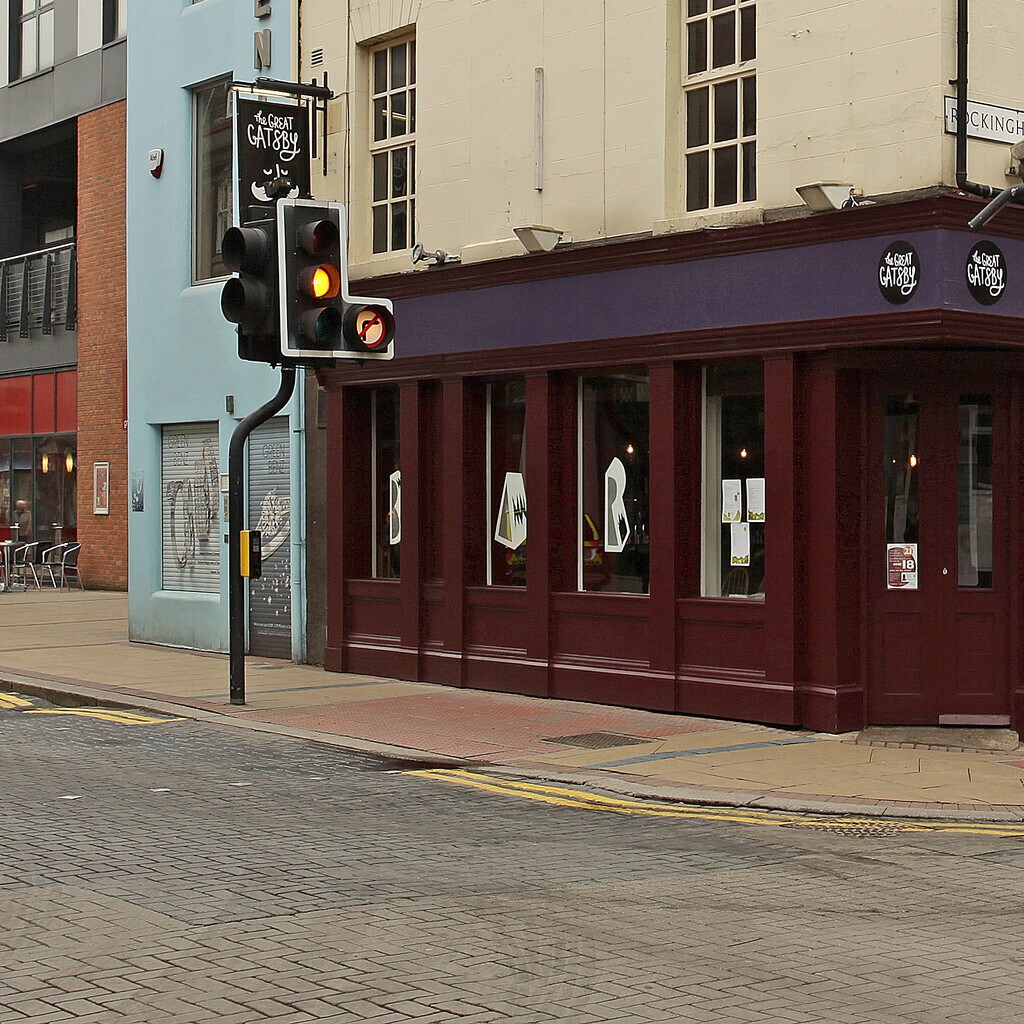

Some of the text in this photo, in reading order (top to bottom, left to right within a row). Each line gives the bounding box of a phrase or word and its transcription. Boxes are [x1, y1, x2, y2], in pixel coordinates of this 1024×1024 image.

[254, 110, 294, 130] the GREAT
[247, 124, 301, 161] GATSBY
[894, 252, 913, 266] GREAT
[981, 253, 1001, 268] GREAT
[879, 266, 917, 295] GATSBY
[967, 264, 1005, 296] GATSBY
[902, 559, 915, 570] 18
